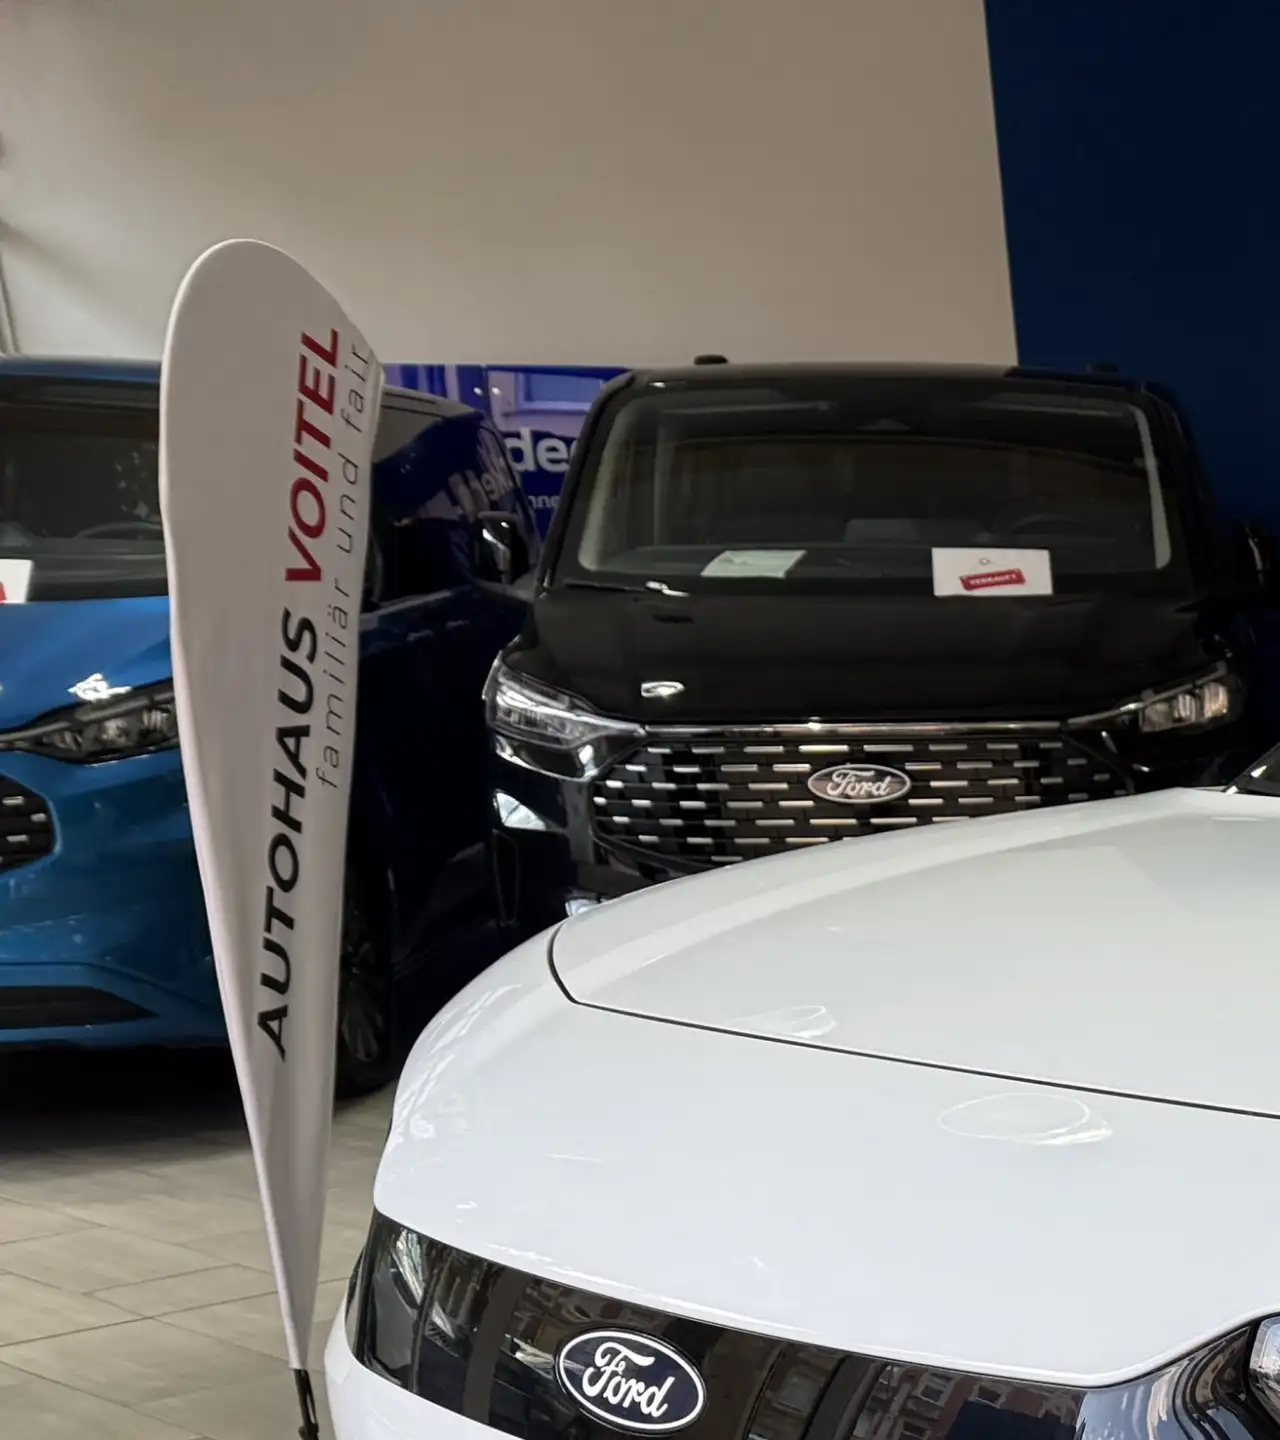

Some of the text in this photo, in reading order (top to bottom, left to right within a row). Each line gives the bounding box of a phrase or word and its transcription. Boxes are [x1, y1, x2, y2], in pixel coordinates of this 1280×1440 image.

[257, 327, 339, 1061] AUTOHAUS VOITEL
[316, 343, 370, 788] familiär und fair
